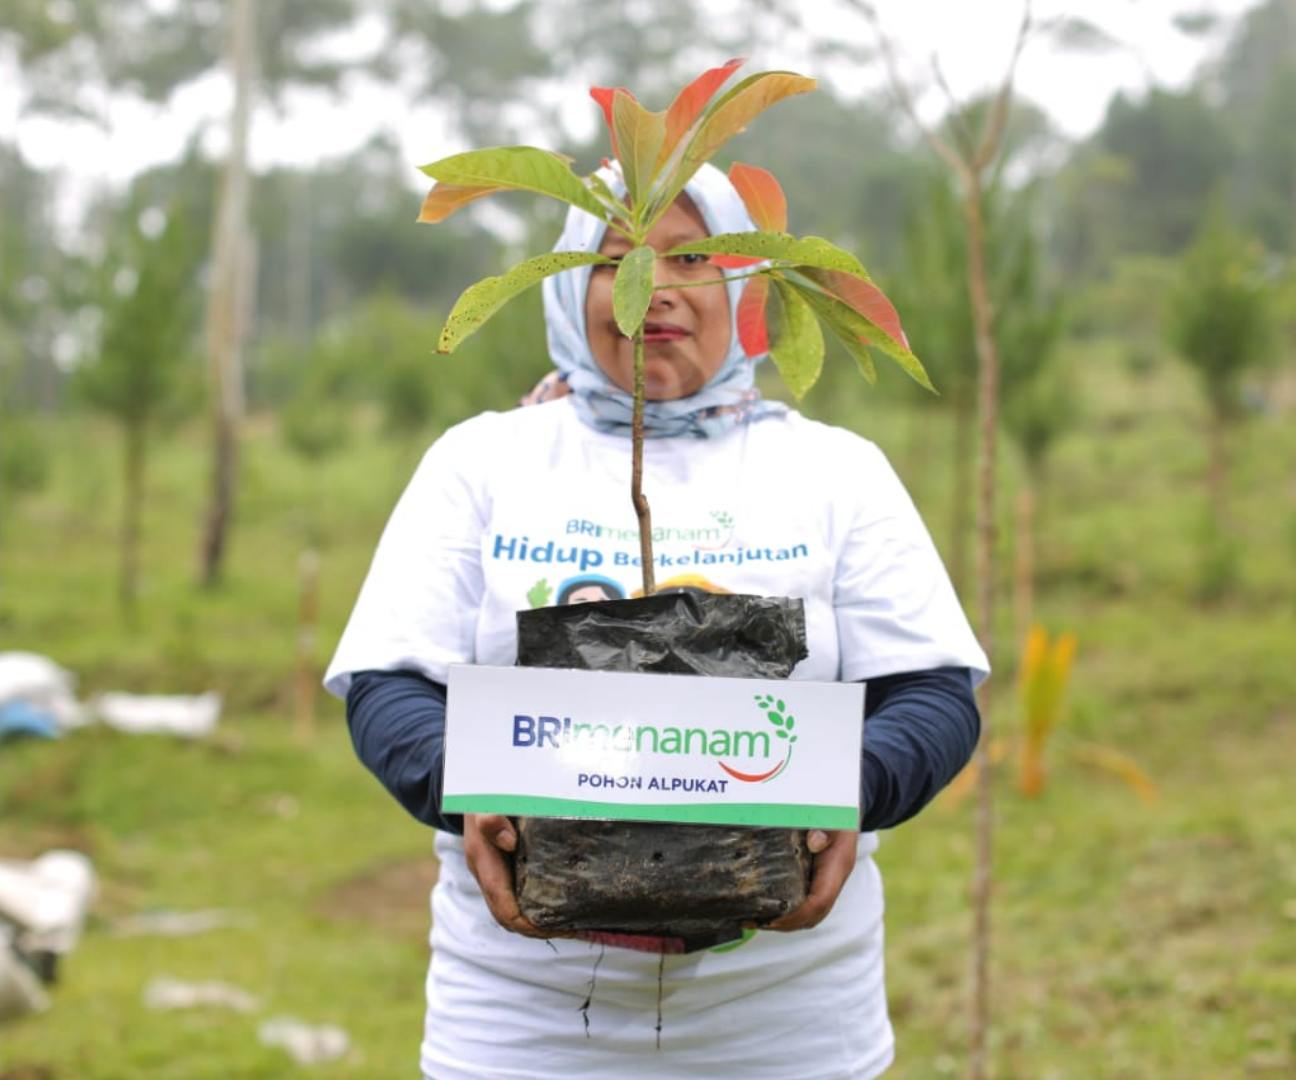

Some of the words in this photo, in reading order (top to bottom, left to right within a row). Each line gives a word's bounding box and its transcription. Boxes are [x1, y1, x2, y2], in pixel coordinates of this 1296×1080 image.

[565, 518, 720, 543] BRImeanam
[492, 534, 604, 571] Hidup
[613, 544, 809, 567] Bekelanjutan
[578, 773, 642, 789] POHON
[648, 775, 729, 793] ALPUKAT
